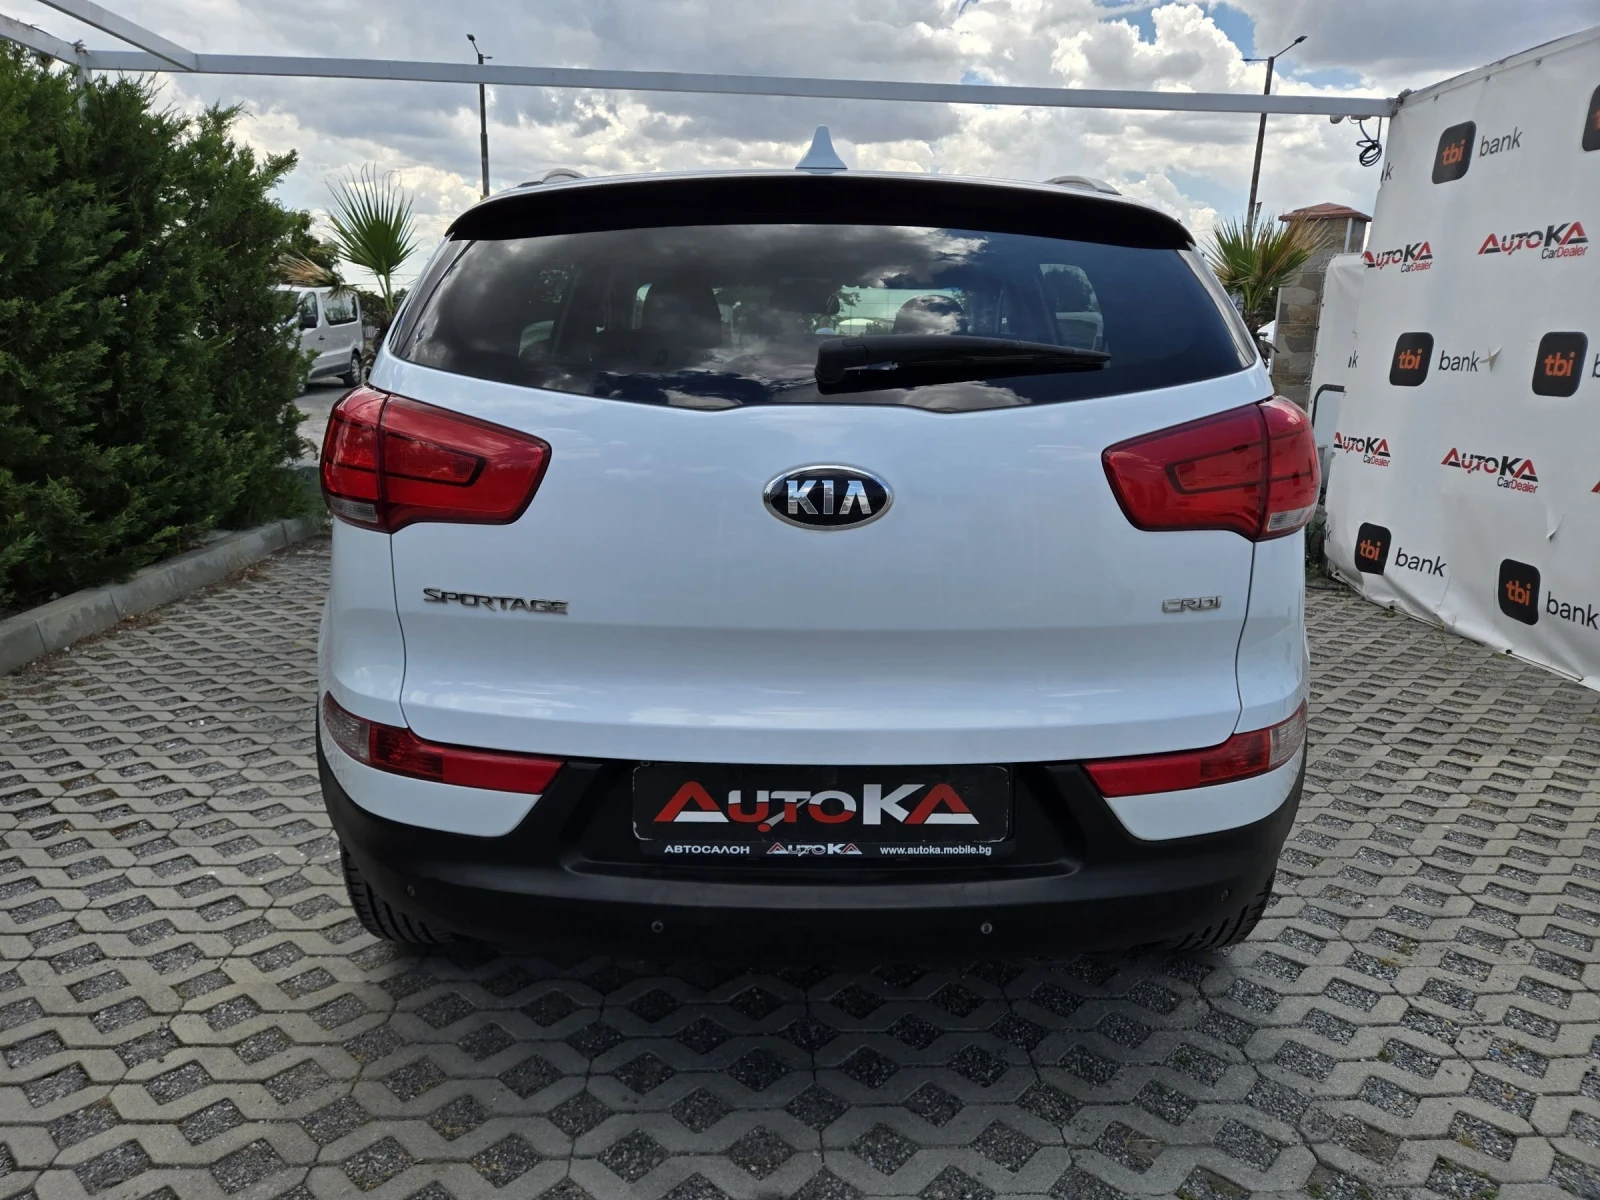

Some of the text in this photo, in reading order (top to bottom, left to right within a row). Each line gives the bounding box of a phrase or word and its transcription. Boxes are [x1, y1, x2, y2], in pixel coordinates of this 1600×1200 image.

[1442, 126, 1523, 166] tbi bank
[1398, 348, 1480, 373] tbi bank
[1544, 351, 1576, 377] tbi
[786, 480, 872, 515] KIA
[1359, 539, 1447, 578] tbi bank
[422, 587, 569, 615] SPORTAGE
[1505, 579, 1600, 631] tbi bank
[664, 844, 750, 855] АВТОСАЛОН
[880, 844, 992, 856] www.autoka.mobile.bg
